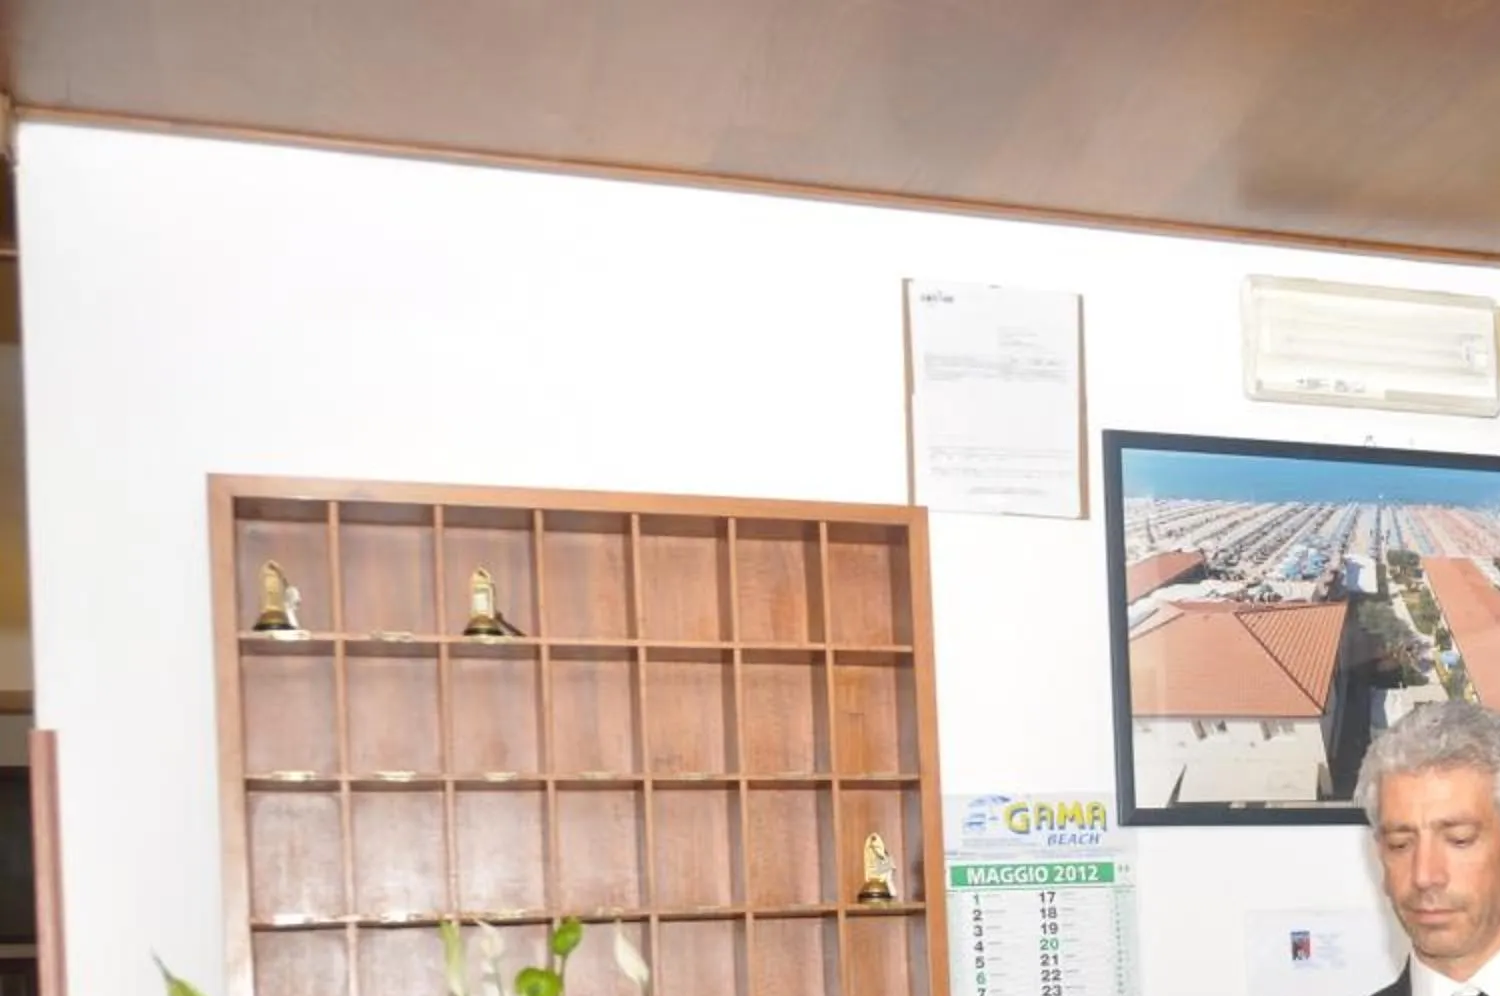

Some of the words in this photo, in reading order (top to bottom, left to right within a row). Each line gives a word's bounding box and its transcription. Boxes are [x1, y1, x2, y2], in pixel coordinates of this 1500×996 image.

[1004, 801, 1107, 835] GAMA
[1047, 832, 1101, 846] BEACH
[967, 866, 1049, 885] MAGGIO
[1053, 864, 1099, 882] 2012
[973, 894, 979, 904] 1
[1039, 891, 1056, 903] 17
[973, 909, 983, 921] 2
[1040, 907, 1057, 919] 18
[973, 925, 983, 937] 3
[1041, 922, 1058, 935] 19
[974, 941, 984, 952] 4
[1040, 938, 1059, 951] 20
[975, 956, 985, 969] 5
[1040, 954, 1059, 966] 21
[976, 972, 986, 985] 6
[1041, 969, 1062, 982] 22
[1042, 985, 1063, 996] 23
